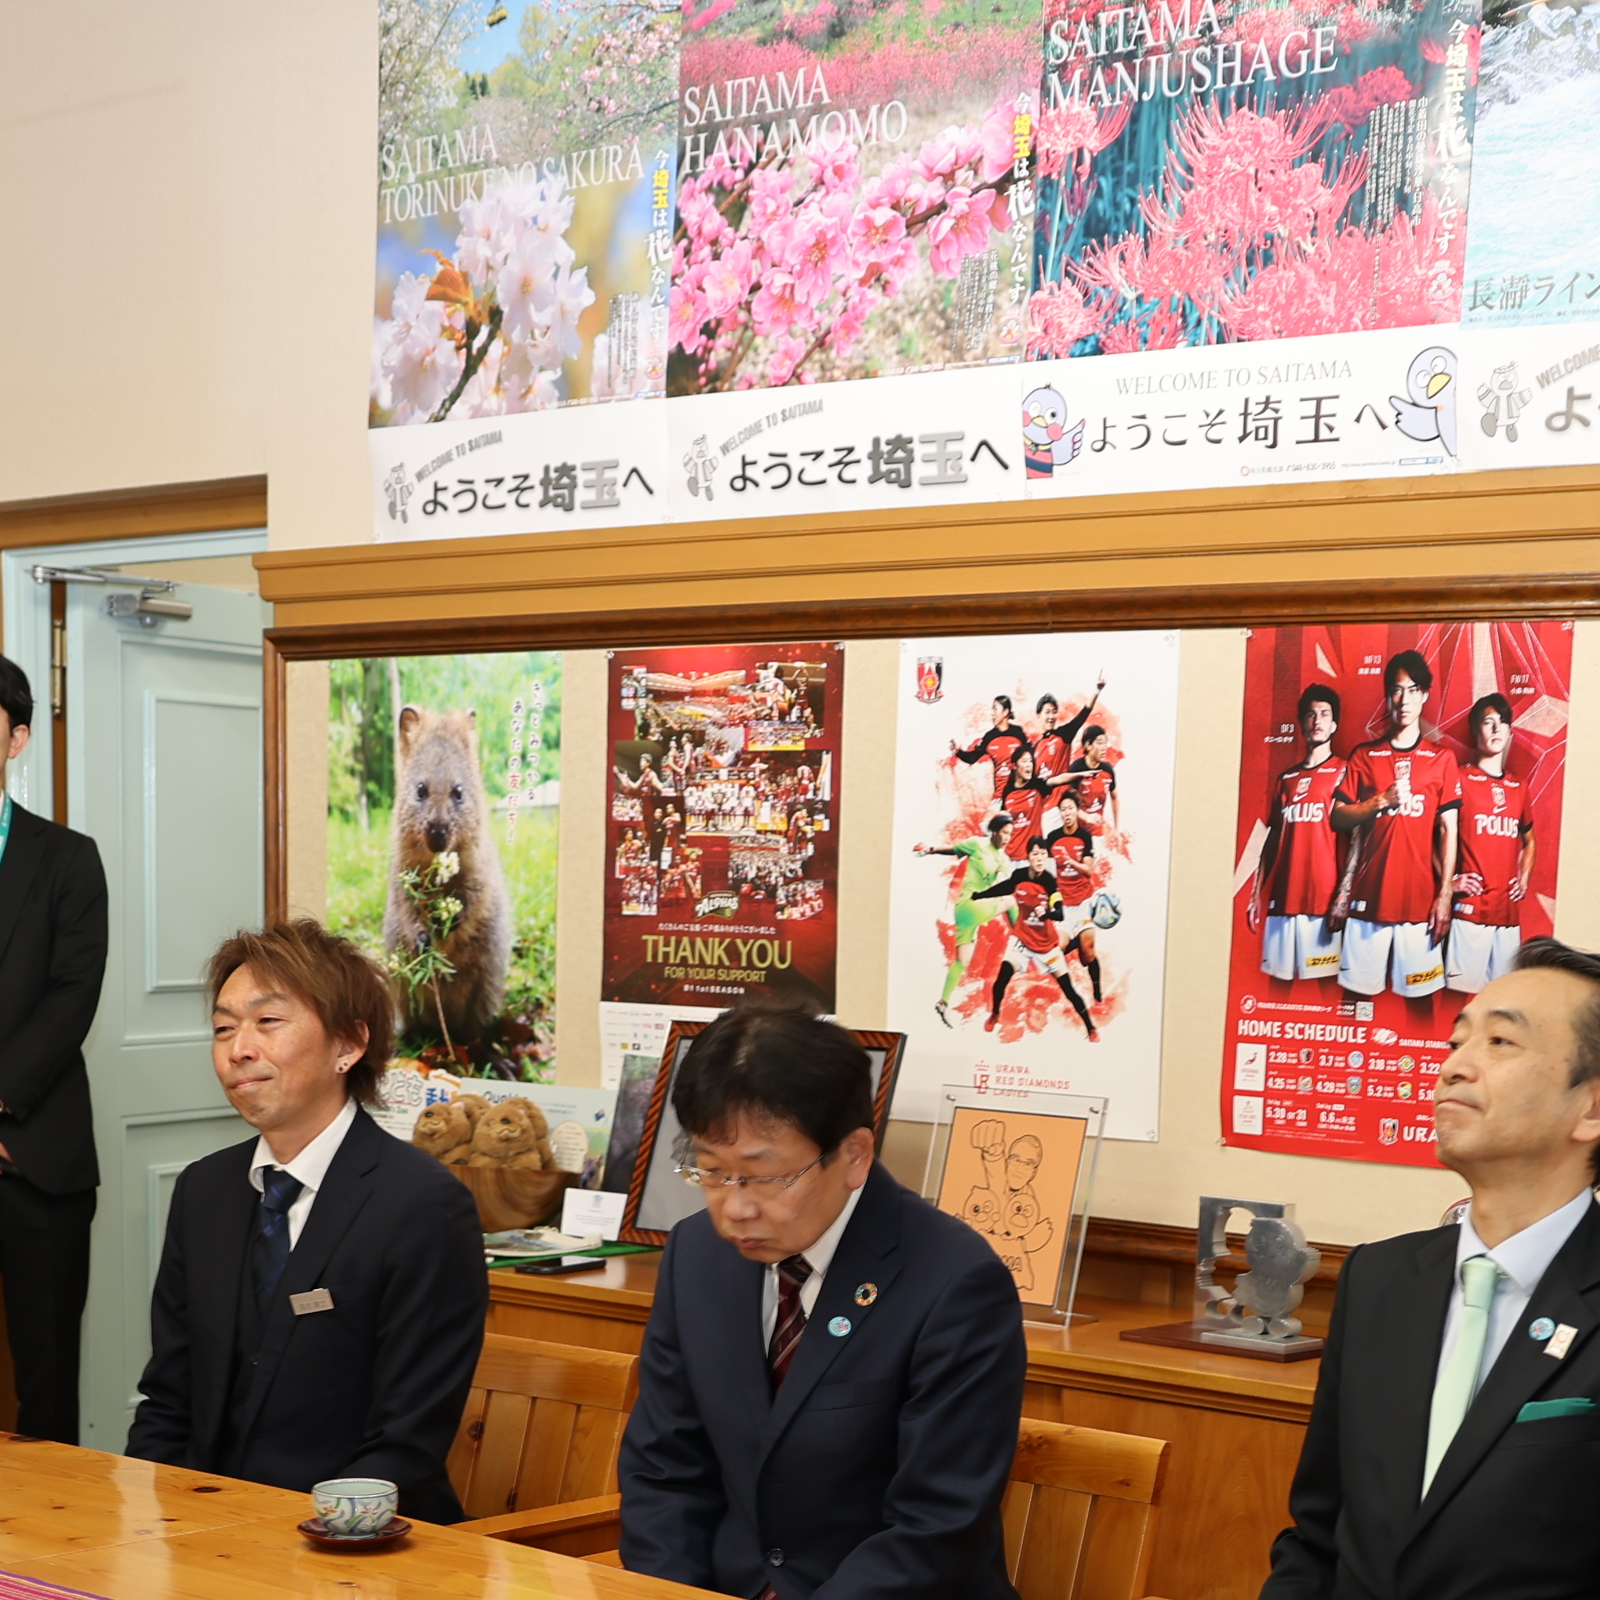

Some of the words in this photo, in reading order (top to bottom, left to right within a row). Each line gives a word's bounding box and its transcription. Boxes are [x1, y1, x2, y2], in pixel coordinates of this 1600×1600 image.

[1050, 0, 1224, 65] SAITAMA
[683, 64, 832, 128] SAITAMA
[1050, 26, 1339, 112] MANJUSHAGE
[381, 122, 499, 182] SAITAMA
[682, 100, 908, 174] HANAMOMO
[1434, 18, 1472, 255] 今埼玉は花なんです
[382, 167, 495, 224] TORINUKE
[542, 142, 646, 191] SAKURA
[1004, 92, 1036, 305] 今埼玉は花なんです
[645, 149, 673, 343] 今埼玉は花なんです
[1116, 370, 1219, 396] WELCOME
[1224, 368, 1251, 388] TO
[1257, 359, 1353, 384] SAITAMA
[719, 420, 764, 456] WELCOME
[765, 413, 778, 429] TO
[781, 399, 824, 422] SAITAMA
[1090, 394, 1390, 452] ようこそ埼玉へ
[415, 449, 454, 483] WELCOME
[455, 442, 466, 457] TO
[468, 430, 503, 453] SAITAMA
[730, 431, 1009, 492] ようこそ埼玉へ
[422, 459, 654, 516] ようこそ埼玉へ
[527, 681, 544, 802] きっとみつかる
[1474, 814, 1519, 837] POLUS
[641, 935, 731, 966] THANK
[735, 938, 792, 969] YOU
[664, 966, 686, 979] FOR
[688, 967, 716, 980] YOUR
[717, 969, 767, 983] SUPPORT
[1311, 956, 1339, 966] DHL
[710, 986, 745, 995] SEASON
[1238, 1019, 1282, 1038] HOME
[1284, 1022, 1367, 1043] SCHEDULE
[995, 1064, 1030, 1074] URAWA
[995, 1076, 1015, 1085] RED
[1018, 1077, 1071, 1089] DIAMONDS
[1319, 1055, 1333, 1066] 3.7
[1367, 1085, 1383, 1096] 5.2
